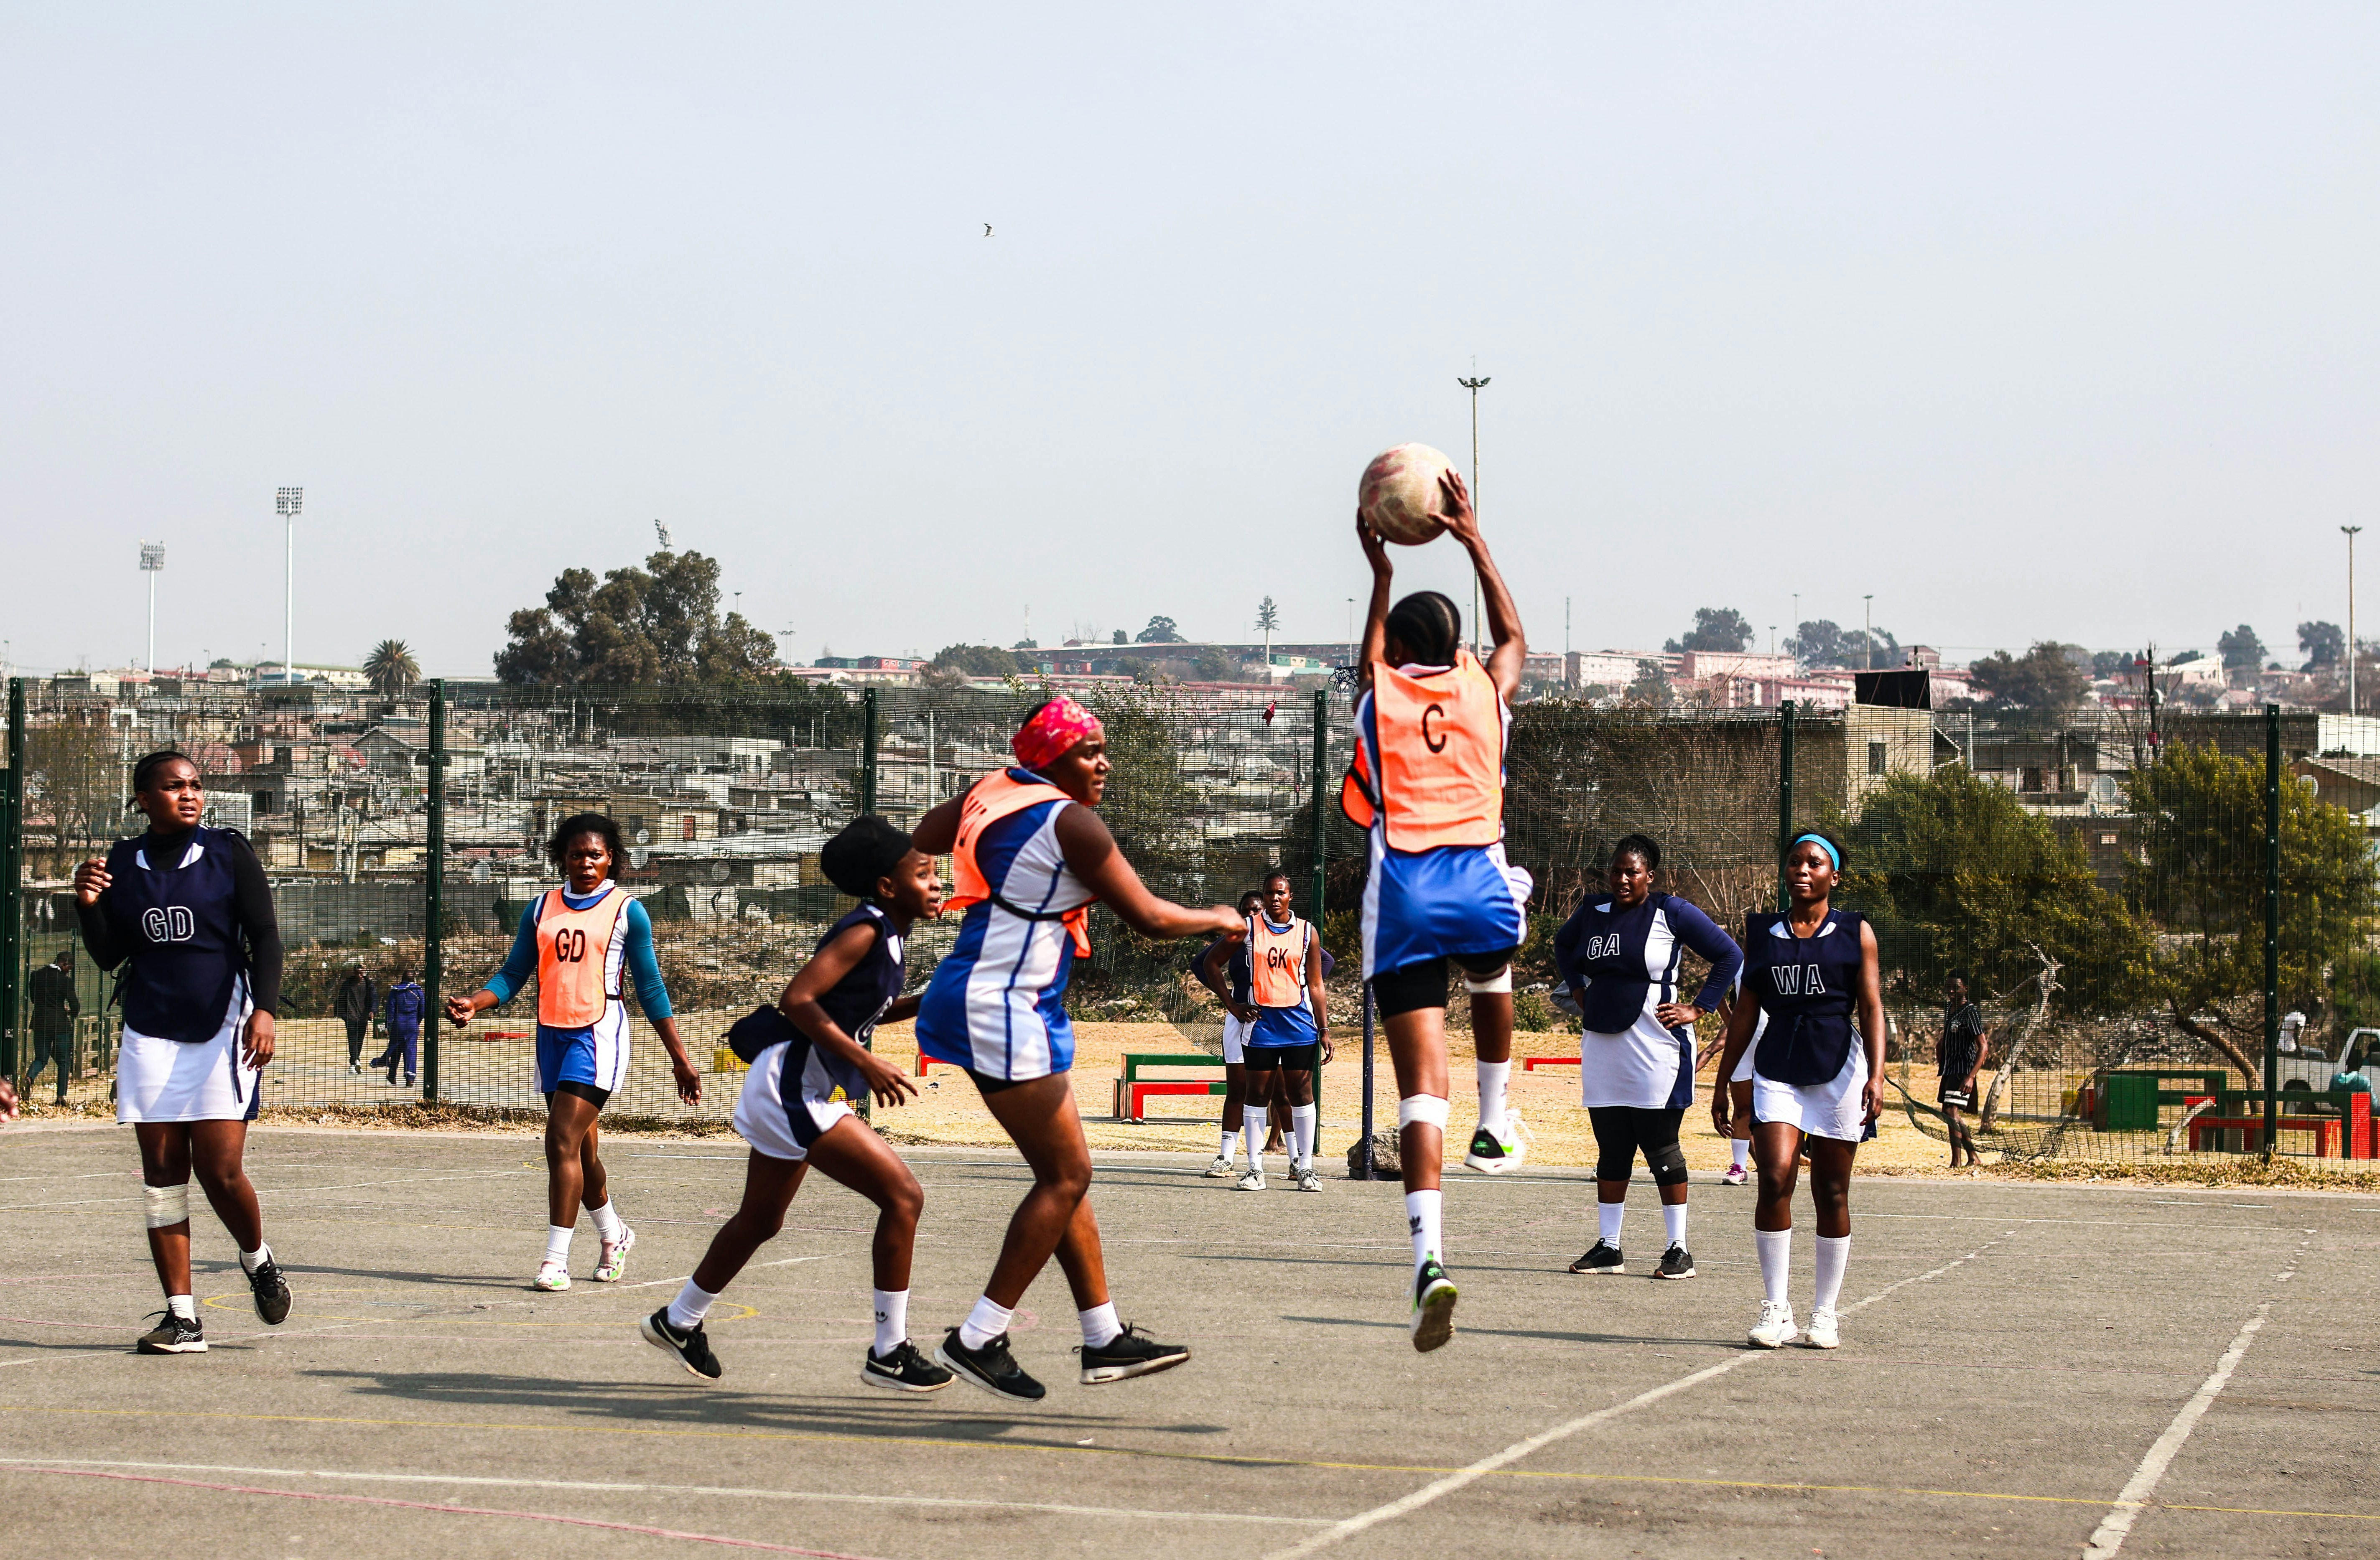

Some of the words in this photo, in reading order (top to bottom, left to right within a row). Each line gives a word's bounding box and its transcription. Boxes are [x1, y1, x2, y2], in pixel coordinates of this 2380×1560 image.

[1422, 704, 1446, 753] C
[142, 906, 194, 942] GD
[555, 928, 585, 963] GD
[1267, 947, 1288, 969] GK
[1587, 933, 1620, 960] GA
[1771, 964, 1826, 995] WA
